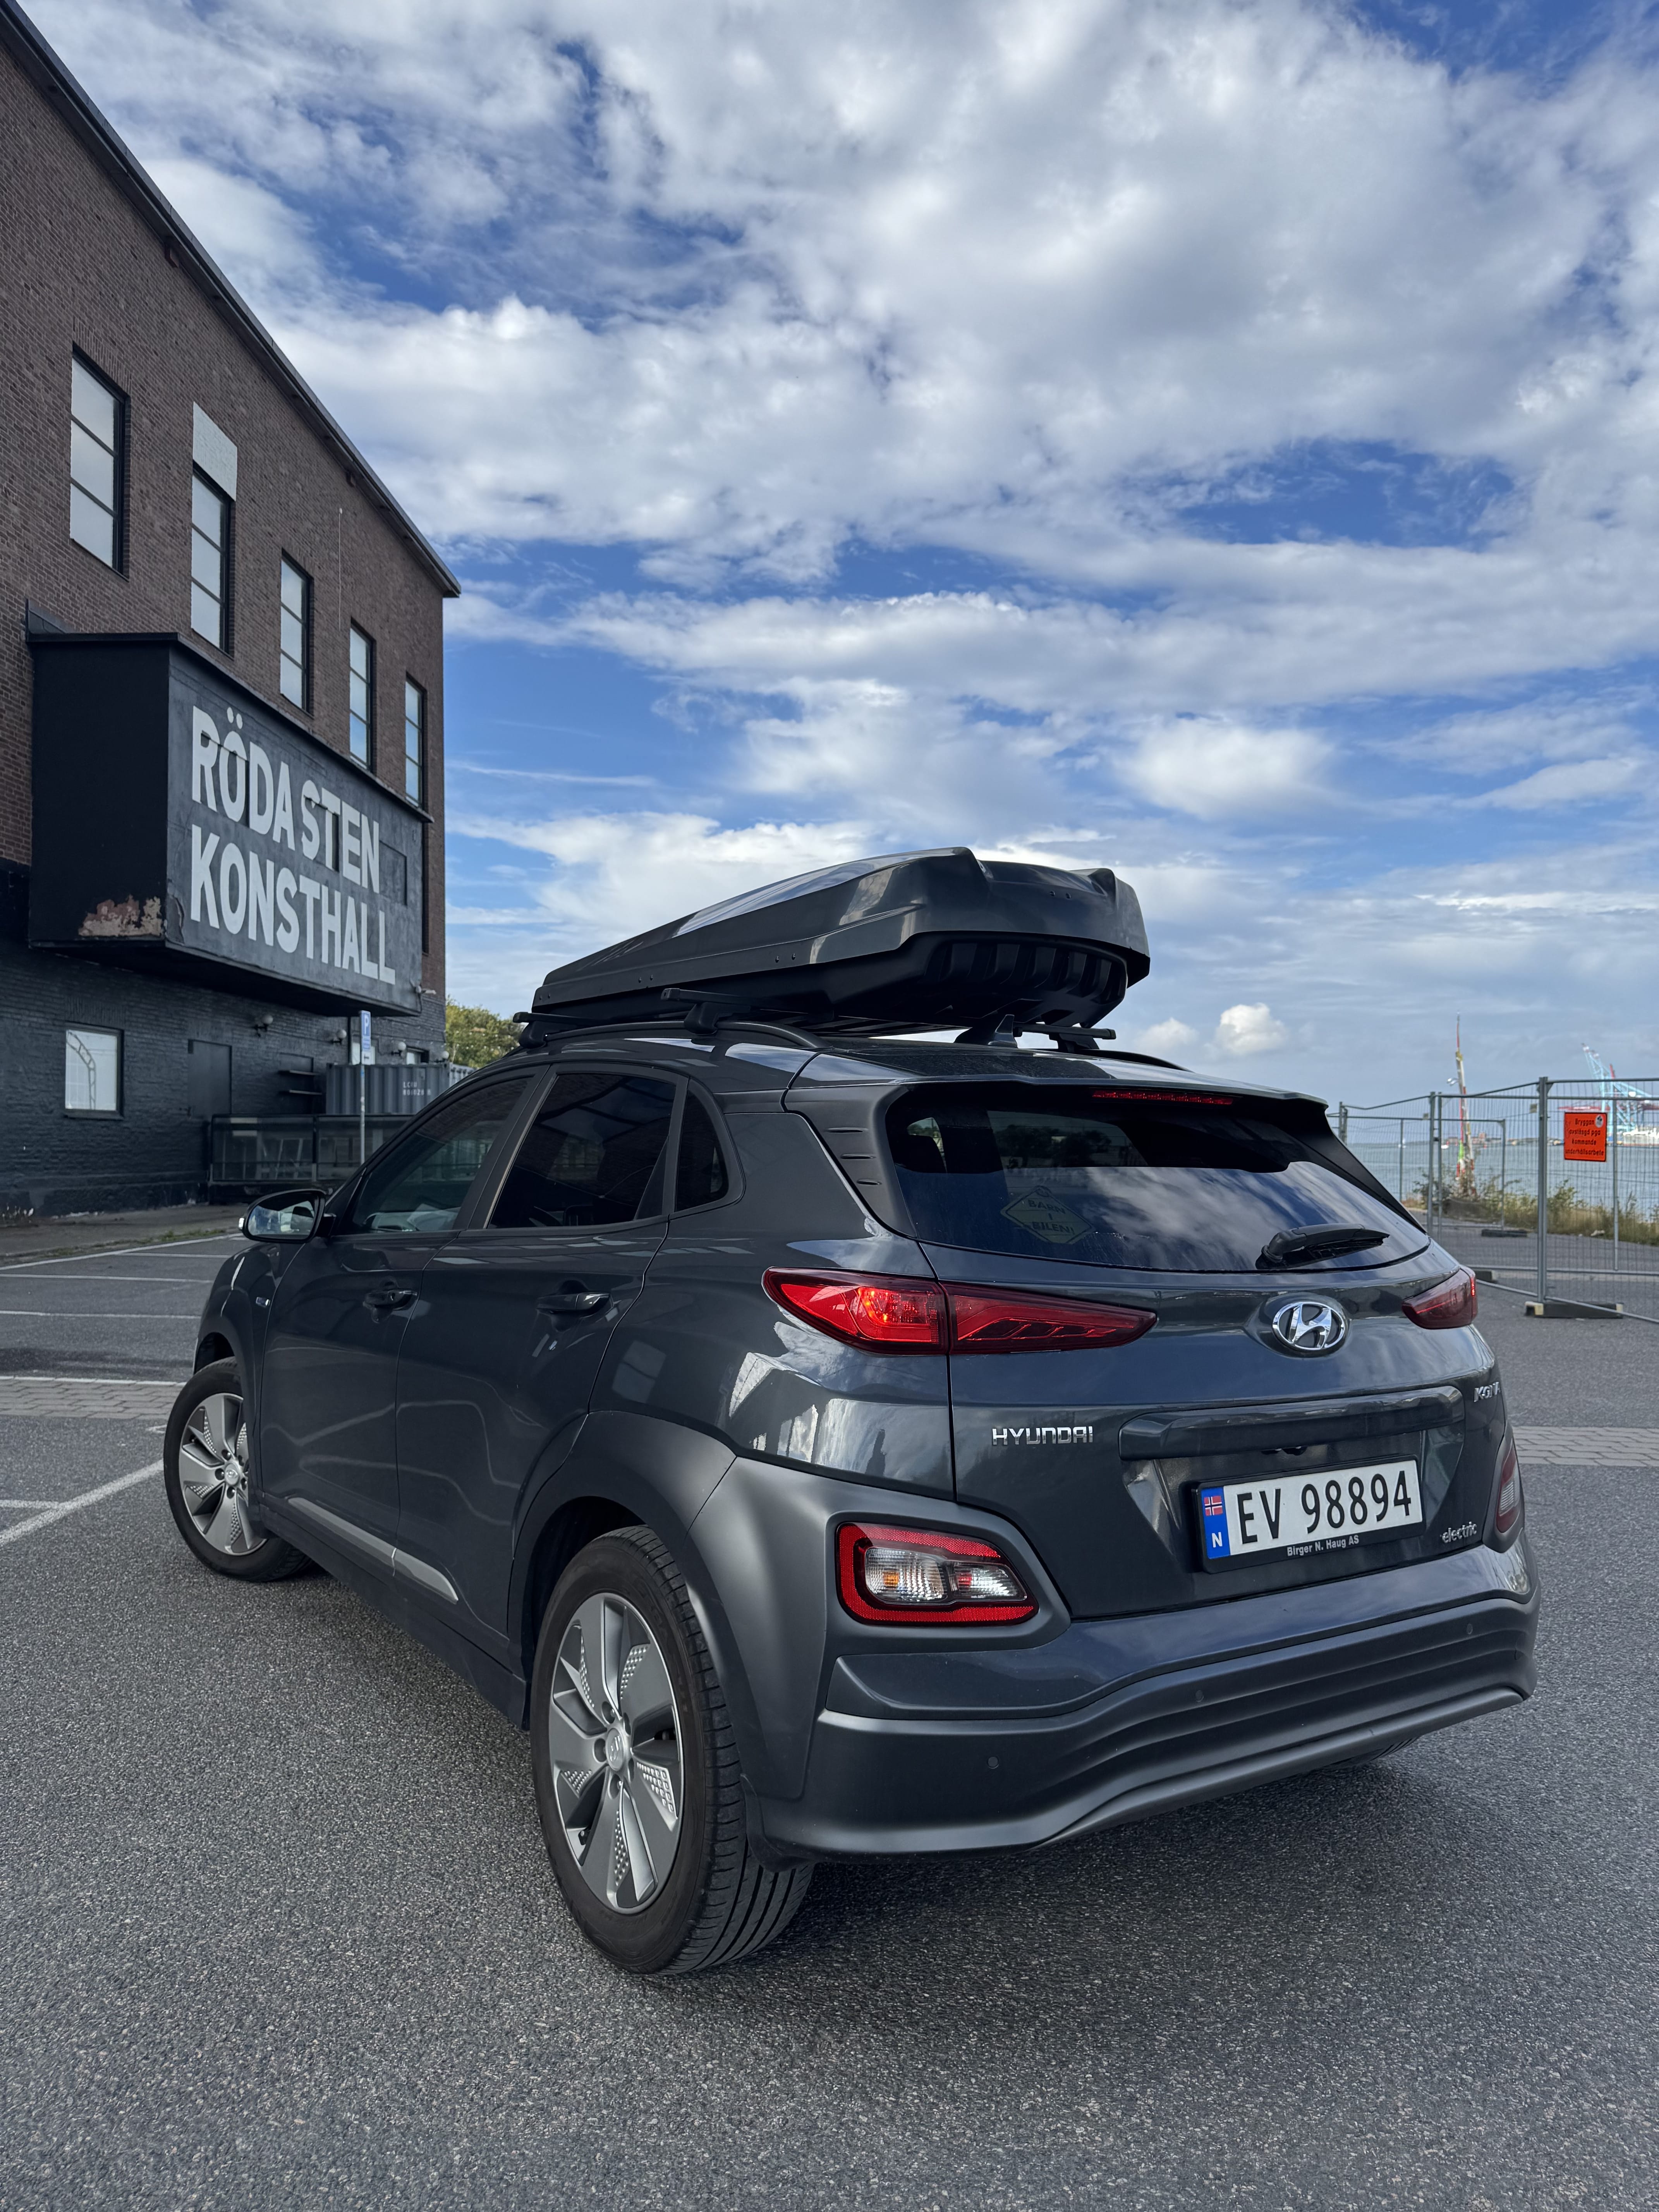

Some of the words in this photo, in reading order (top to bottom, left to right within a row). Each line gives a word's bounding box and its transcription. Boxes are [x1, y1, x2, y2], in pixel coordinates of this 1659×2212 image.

[192, 706, 295, 851] RÖDA
[301, 780, 380, 893] STEN
[191, 824, 395, 985] KONSTHALL
[364, 1014, 369, 1035] P
[1028, 1199, 1066, 1214] BARN
[1032, 1221, 1075, 1235] BILEN!
[992, 1426, 1093, 1446] HYUNDAI
[1237, 1488, 1281, 1544] EV
[1301, 1470, 1412, 1534] 98894
[1211, 1532, 1223, 1548] N
[1441, 1521, 1477, 1543] electric
[1287, 1545, 1312, 1556] Birger
[1315, 1541, 1324, 1551] N.
[1326, 1539, 1346, 1548] Haug
[1348, 1535, 1359, 1545] AS
